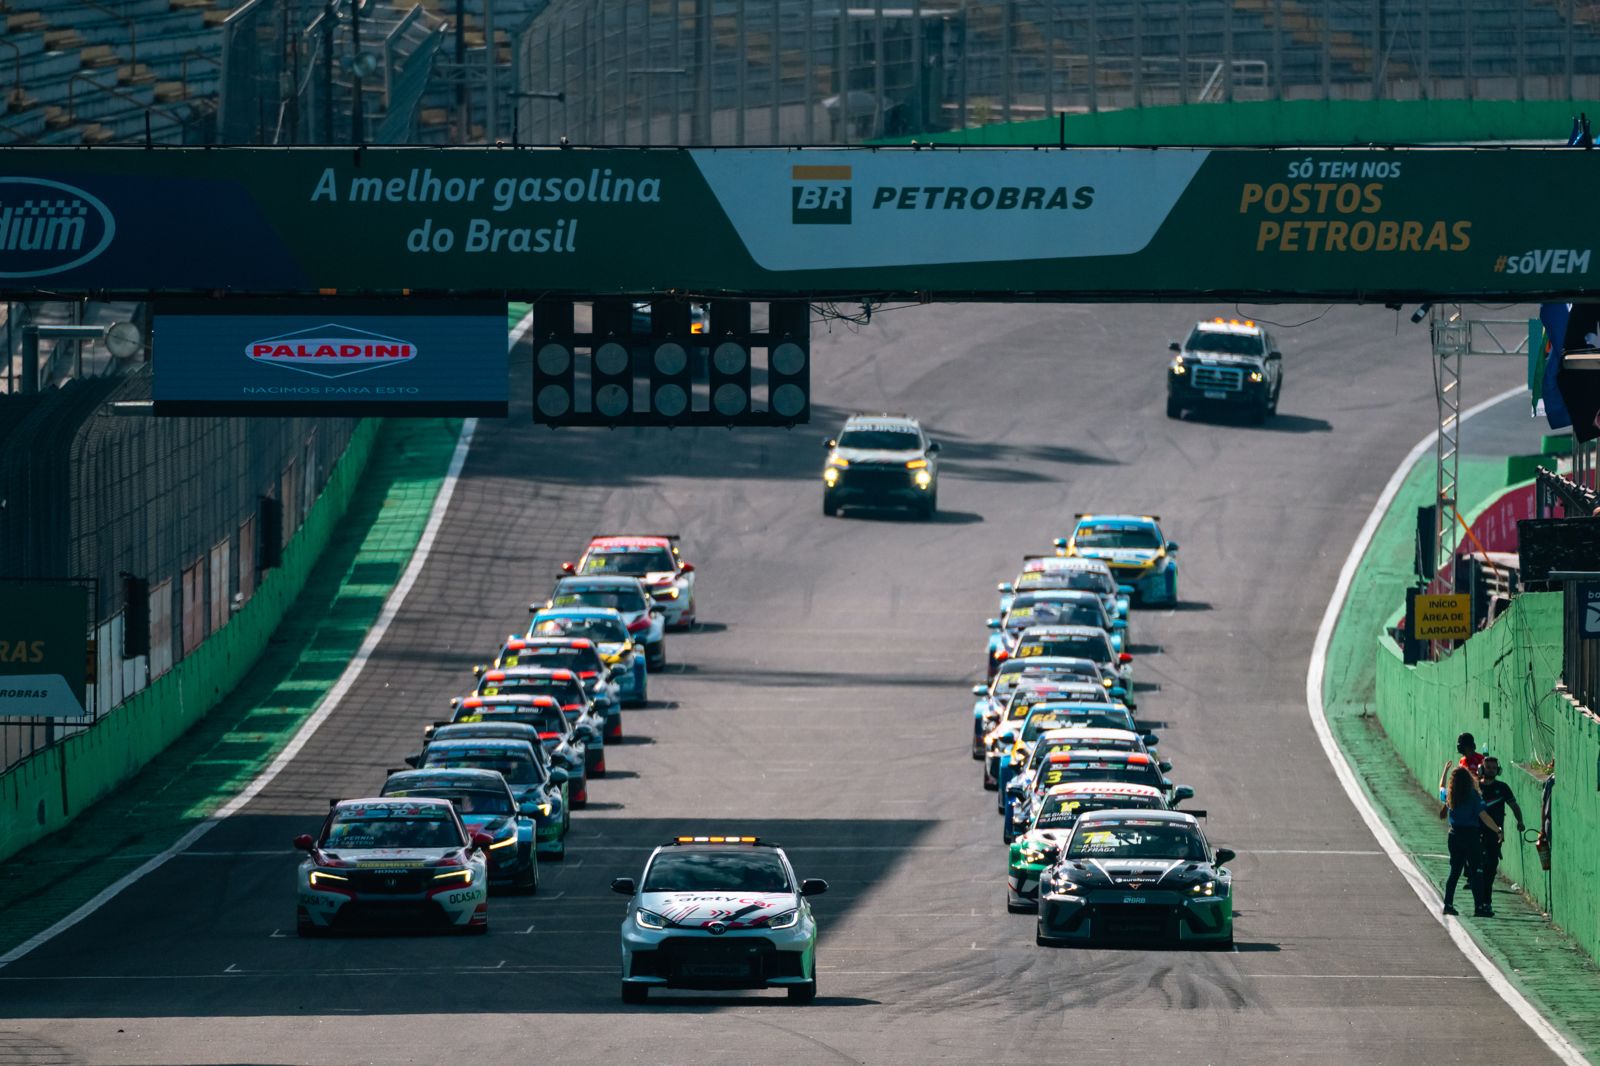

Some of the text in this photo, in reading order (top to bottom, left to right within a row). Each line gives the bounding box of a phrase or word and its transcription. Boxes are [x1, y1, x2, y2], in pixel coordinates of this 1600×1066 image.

[1288, 158, 1402, 179] SÓ TEM NOS
[311, 168, 662, 212] A melhor gasolina
[796, 186, 846, 210] BR
[872, 186, 1095, 210] PETROBRAS
[1239, 183, 1384, 214] POSTOS
[406, 218, 578, 253] do Brasil
[1256, 220, 1473, 251] PETROBRAS
[253, 345, 411, 357] PALADINI
[243, 386, 419, 394] NACIMOS PARA ESTO
[1450, 613, 1464, 621] DE
[1420, 625, 1468, 636] LARGADA
[1046, 770, 1063, 784] 3
[1082, 831, 1112, 844] 77
[450, 890, 476, 904] OCASA
